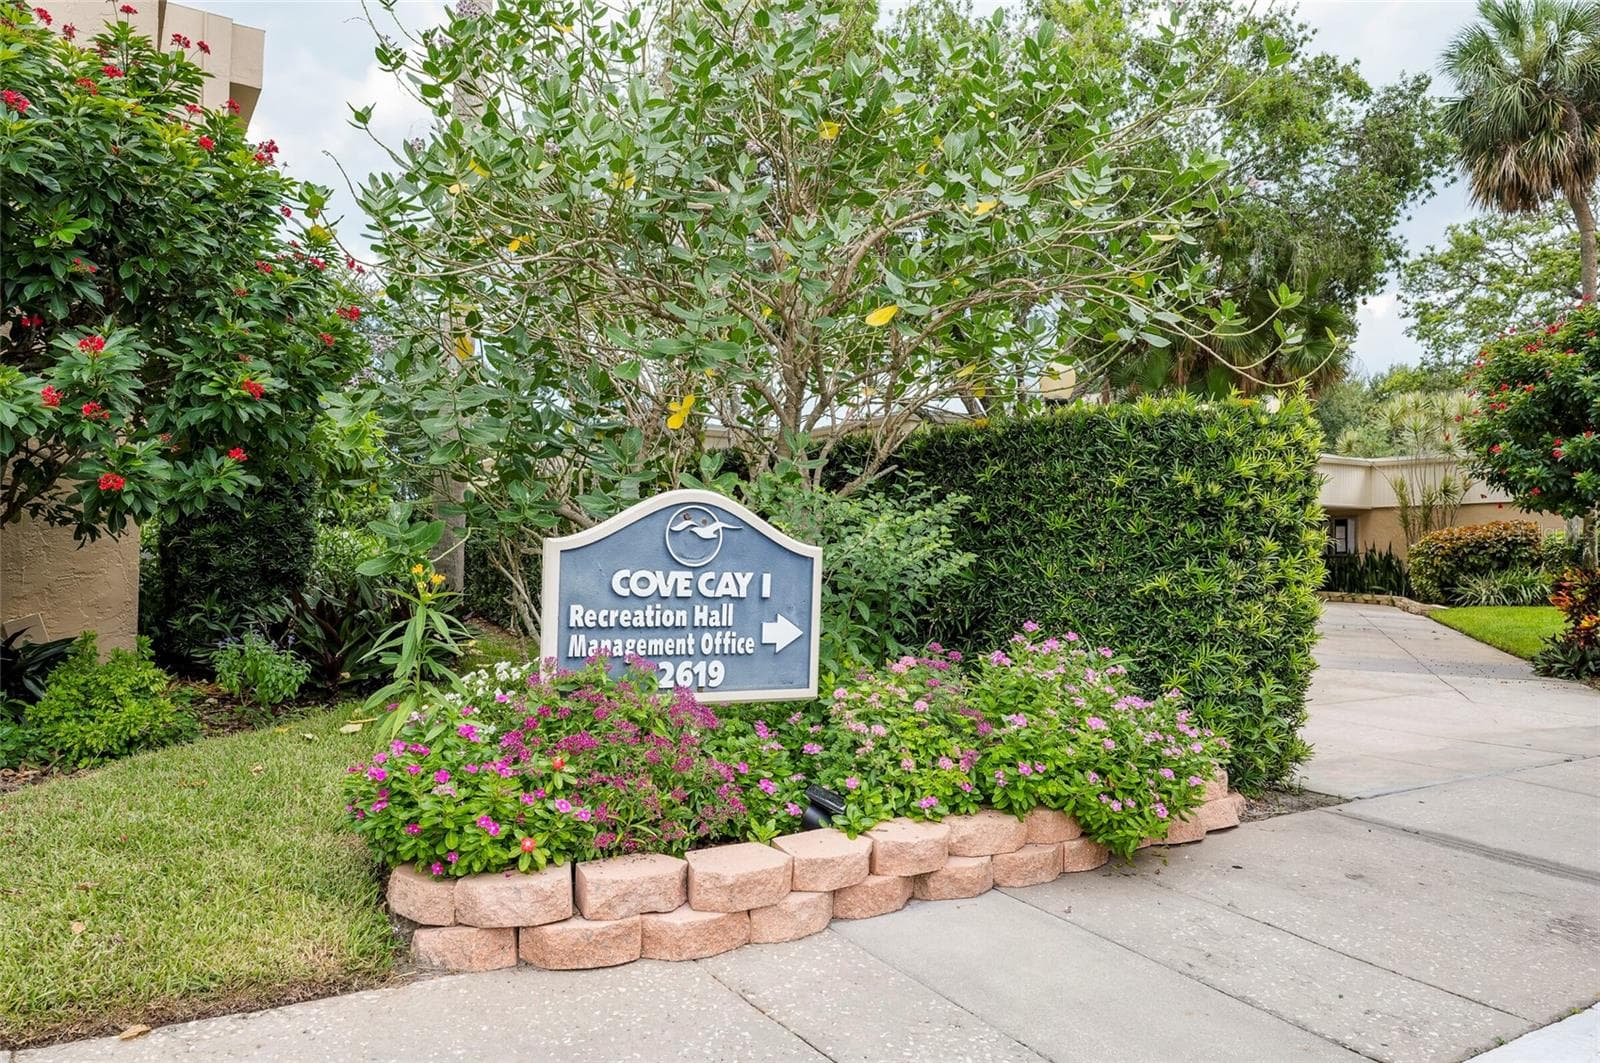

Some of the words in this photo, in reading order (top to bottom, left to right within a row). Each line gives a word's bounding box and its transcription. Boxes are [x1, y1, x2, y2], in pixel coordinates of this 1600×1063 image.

[611, 569, 694, 597] COVE
[697, 571, 754, 598] CAY
[569, 603, 687, 628] Recreation
[693, 603, 734, 627] Hall
[568, 632, 695, 663] Management
[700, 630, 755, 655] Office
[658, 660, 726, 689] 2619
